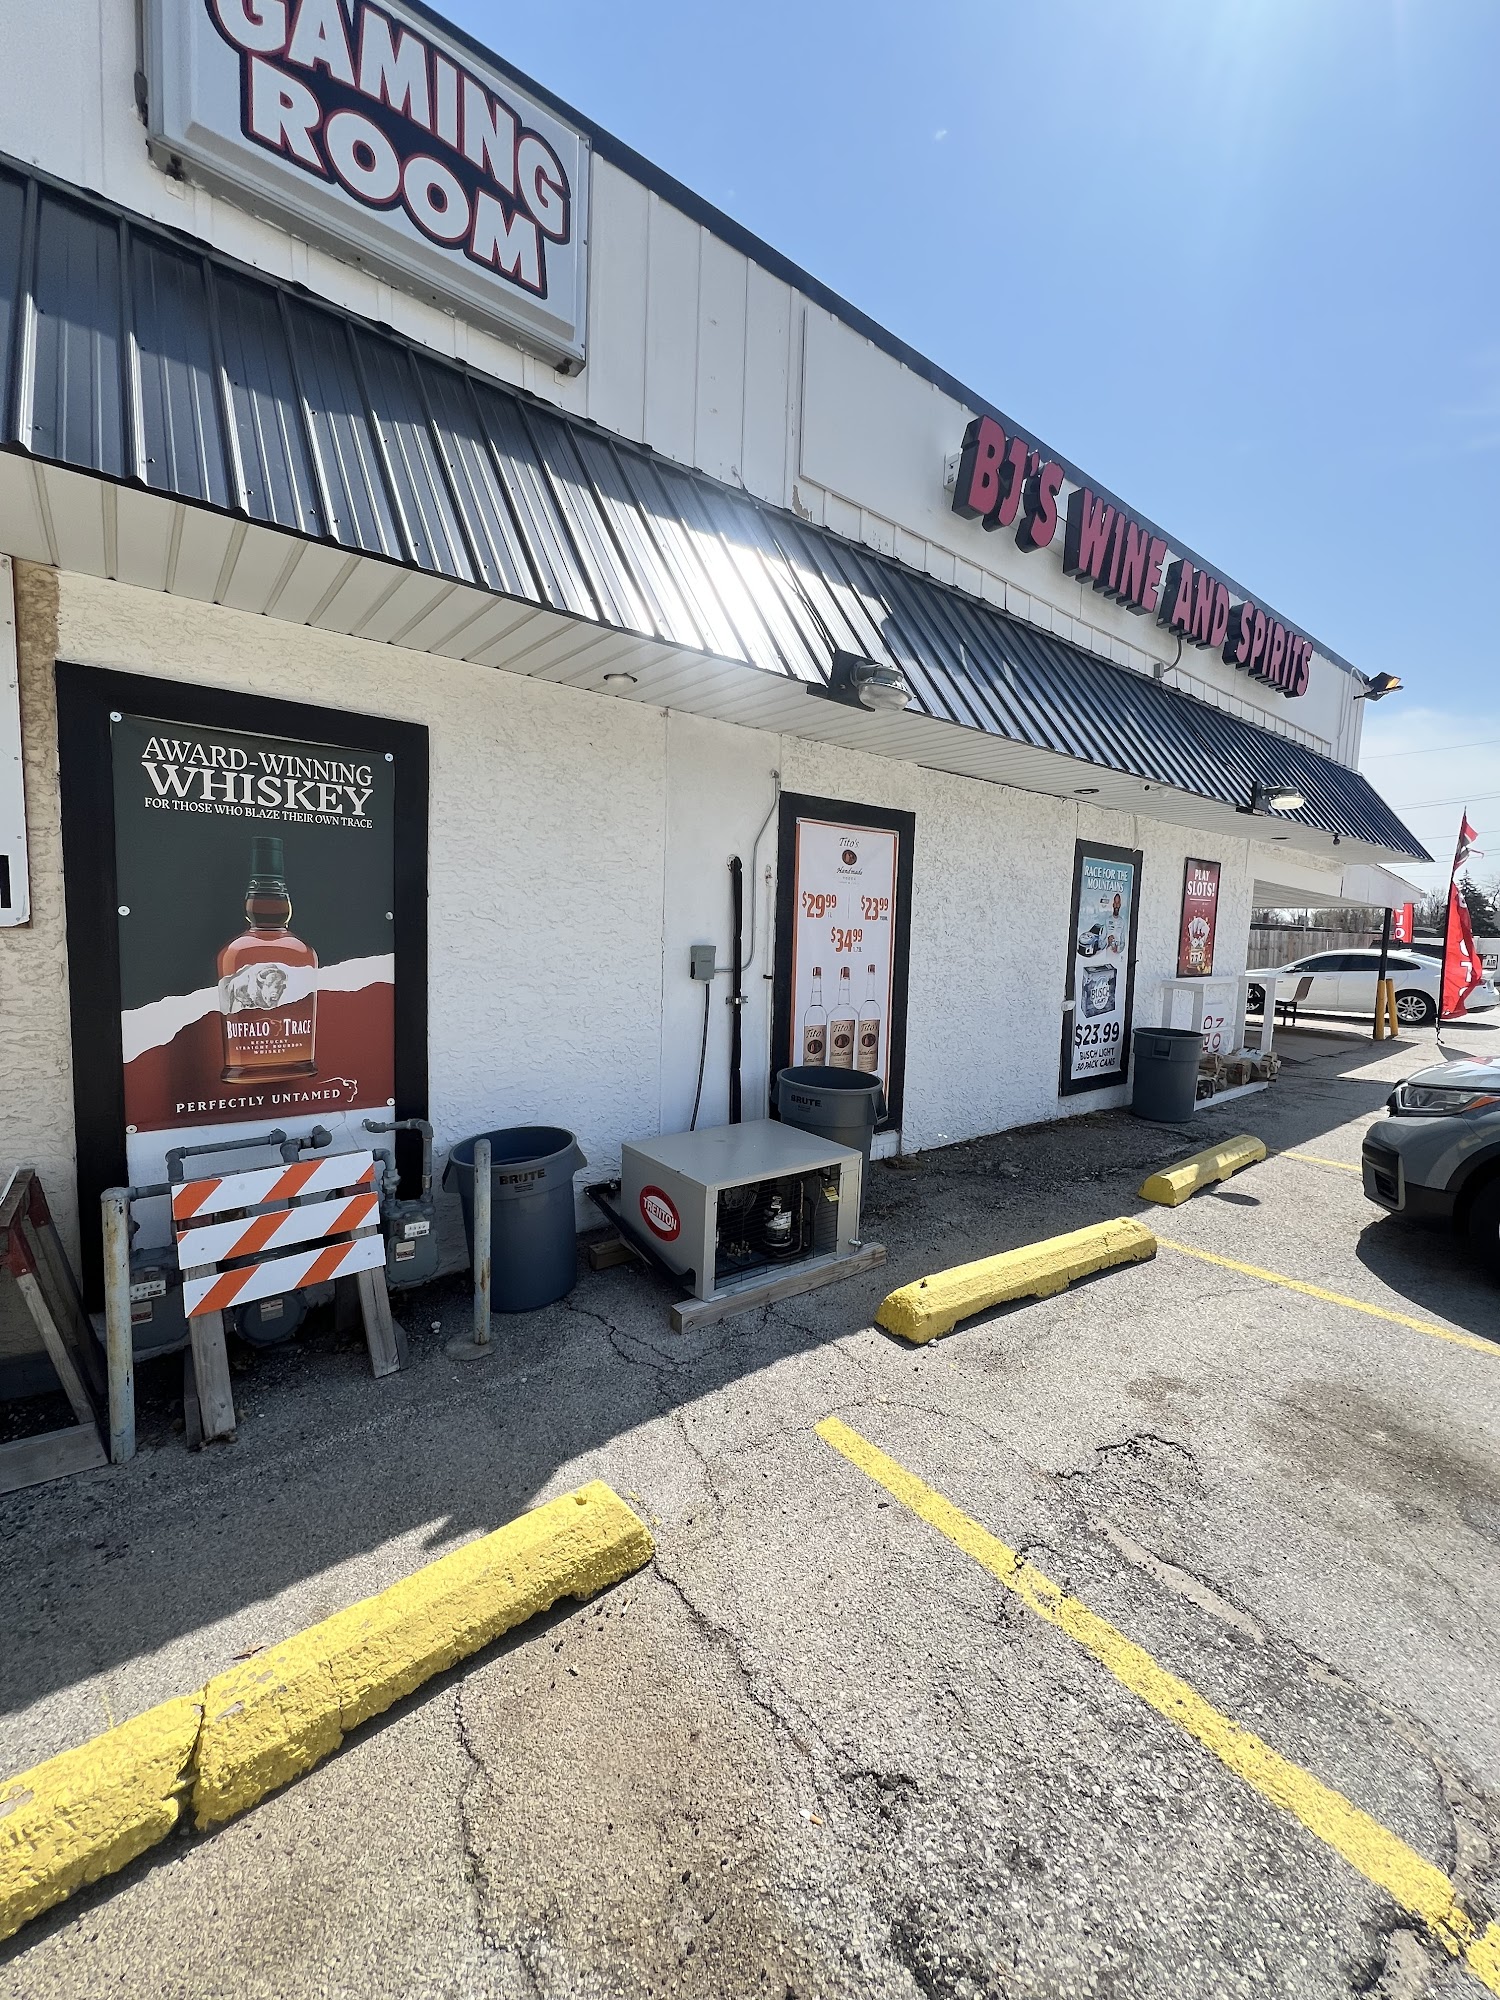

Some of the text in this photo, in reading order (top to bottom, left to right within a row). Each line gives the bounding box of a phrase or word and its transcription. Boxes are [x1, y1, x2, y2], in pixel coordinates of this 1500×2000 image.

[249, 55, 542, 292] ROOM
[967, 413, 1313, 698] BJ'S WINE AND SPIRITS
[141, 736, 373, 787] AWARD-WINNING
[140, 761, 374, 816] WHISKEY
[144, 797, 373, 829] FOR THOSE WHO BLAZE THEIR OWN TRACE
[838, 836, 860, 848] Tito's
[1084, 865, 1128, 882] RACE FOR THE
[1194, 869, 1210, 881] PLAY
[1087, 878, 1124, 893] MOUNTAINS
[1187, 881, 1216, 897] SLOTS!
[1486, 959, 1497, 967] AIR
[1091, 985, 1110, 1000] BUSCH
[226, 1018, 312, 1039] BUFFALO TRACE
[1075, 1021, 1120, 1049] $23.99
[1080, 1047, 1115, 1061] BUSCH LIGHT
[176, 1088, 341, 1113] PERFECTLY UNTAMED
[790, 1094, 822, 1107] BRUTE
[499, 1168, 545, 1185] BRUTE
[643, 1196, 677, 1230] TRENTON
